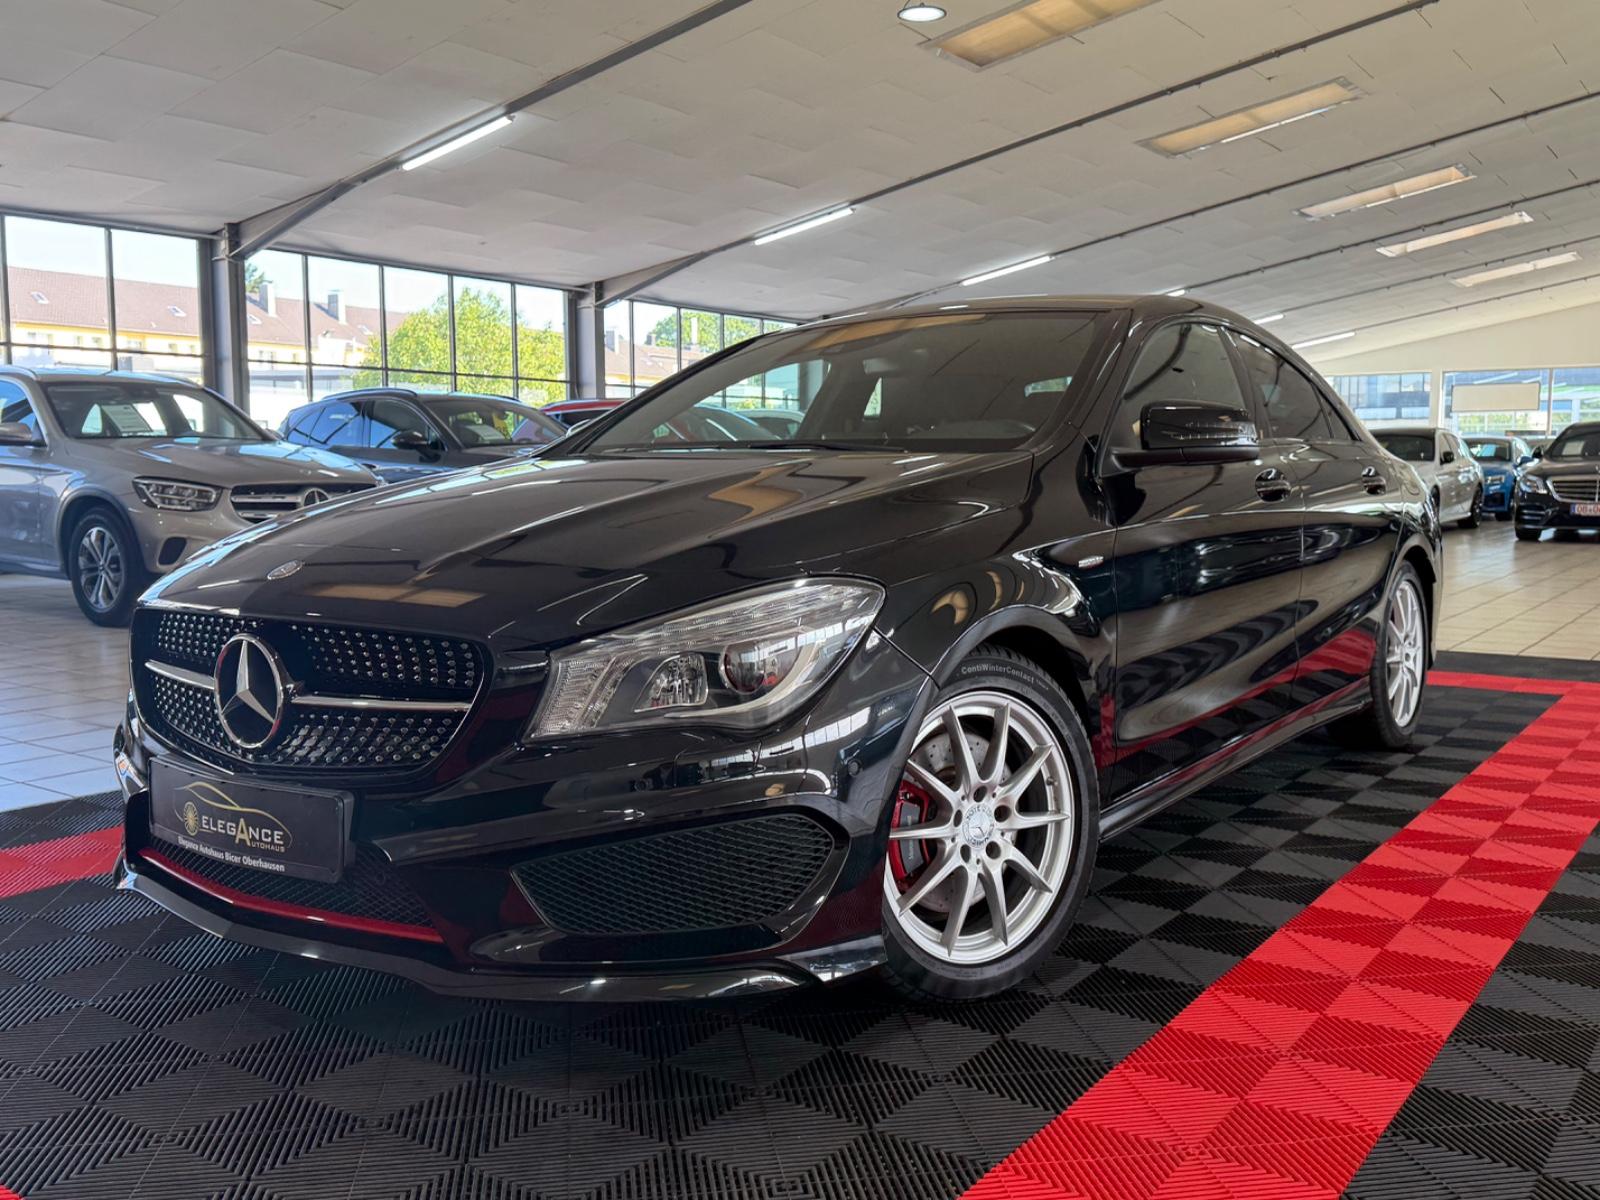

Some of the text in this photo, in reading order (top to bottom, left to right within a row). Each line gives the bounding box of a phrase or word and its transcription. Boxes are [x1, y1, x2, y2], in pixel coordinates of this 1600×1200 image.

[961, 663, 1035, 685] ContiWinterContact
[202, 815, 284, 846] ELEGANCE
[178, 836, 285, 872] Elegance Autohaus Bicer Oberhausen
